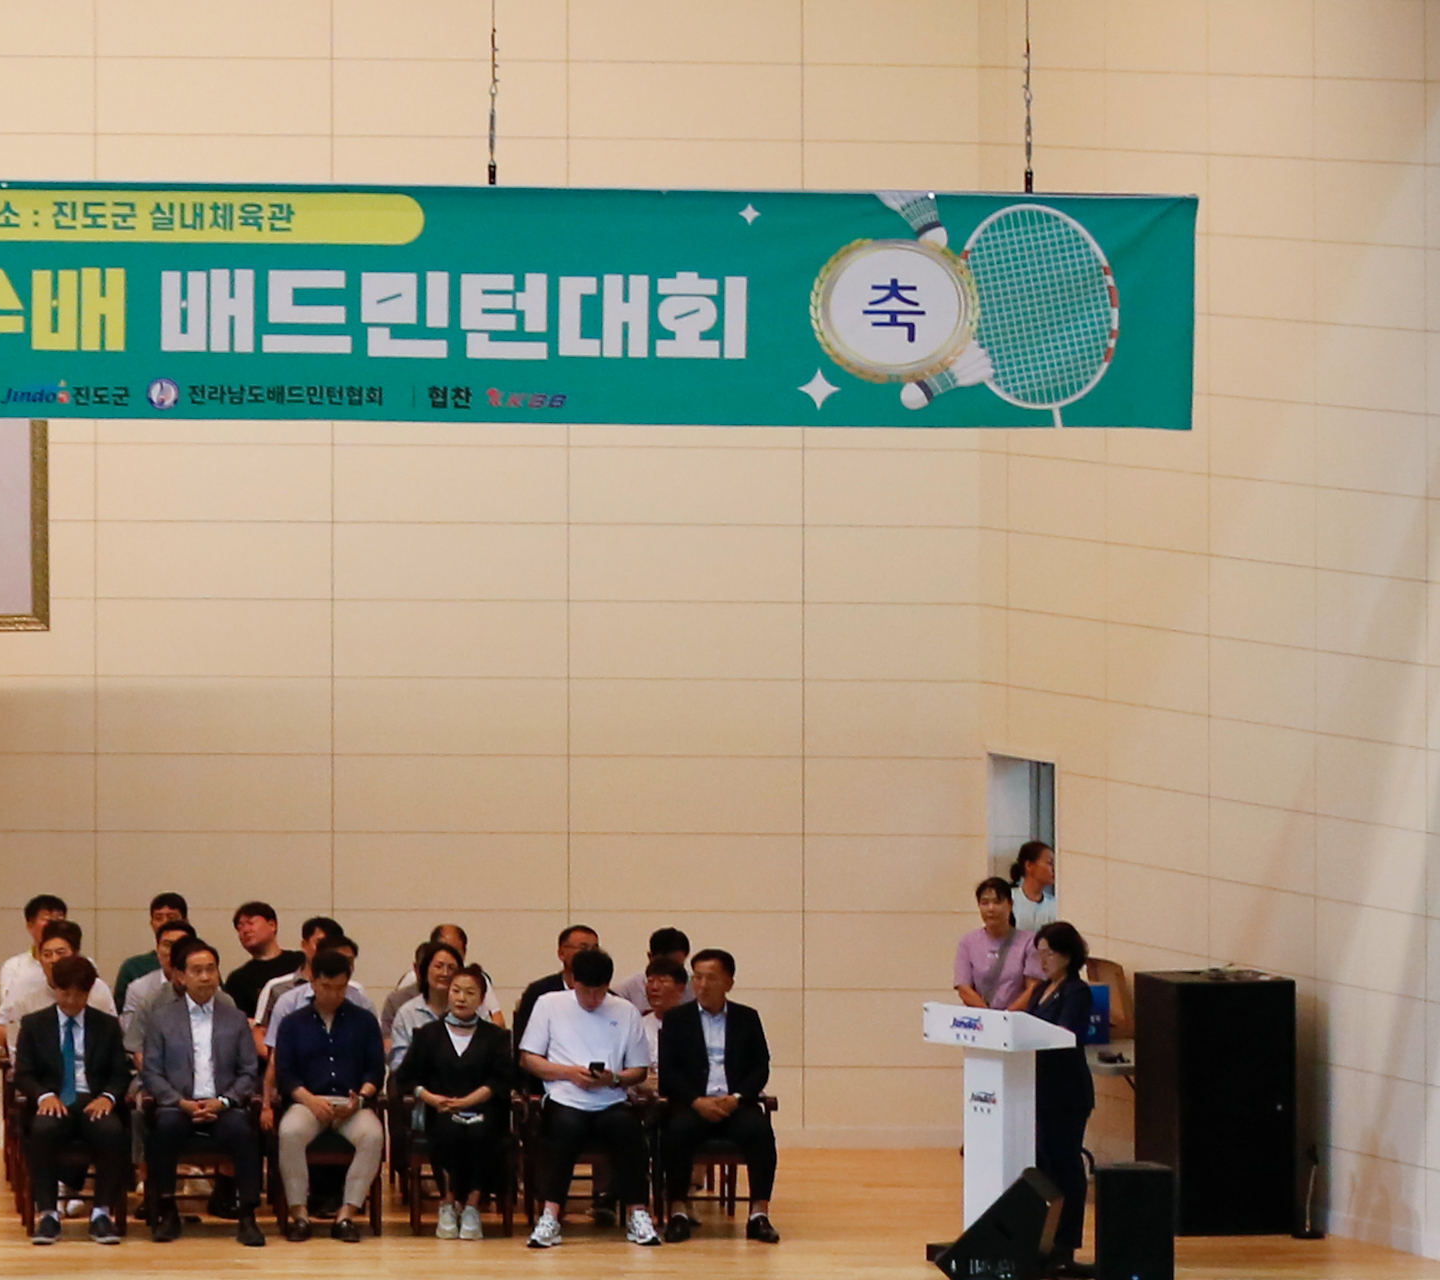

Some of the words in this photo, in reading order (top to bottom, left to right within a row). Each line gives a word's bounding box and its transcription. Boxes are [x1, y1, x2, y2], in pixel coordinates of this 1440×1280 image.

[52, 201, 138, 231] 진도군
[148, 202, 296, 232] 실내체육관
[160, 269, 747, 360] 배드민턴대회
[861, 277, 928, 346] 축
[72, 386, 130, 406] 진도군
[187, 384, 383, 406] 전라남도배드민턴협회
[427, 386, 473, 409] 협찬
